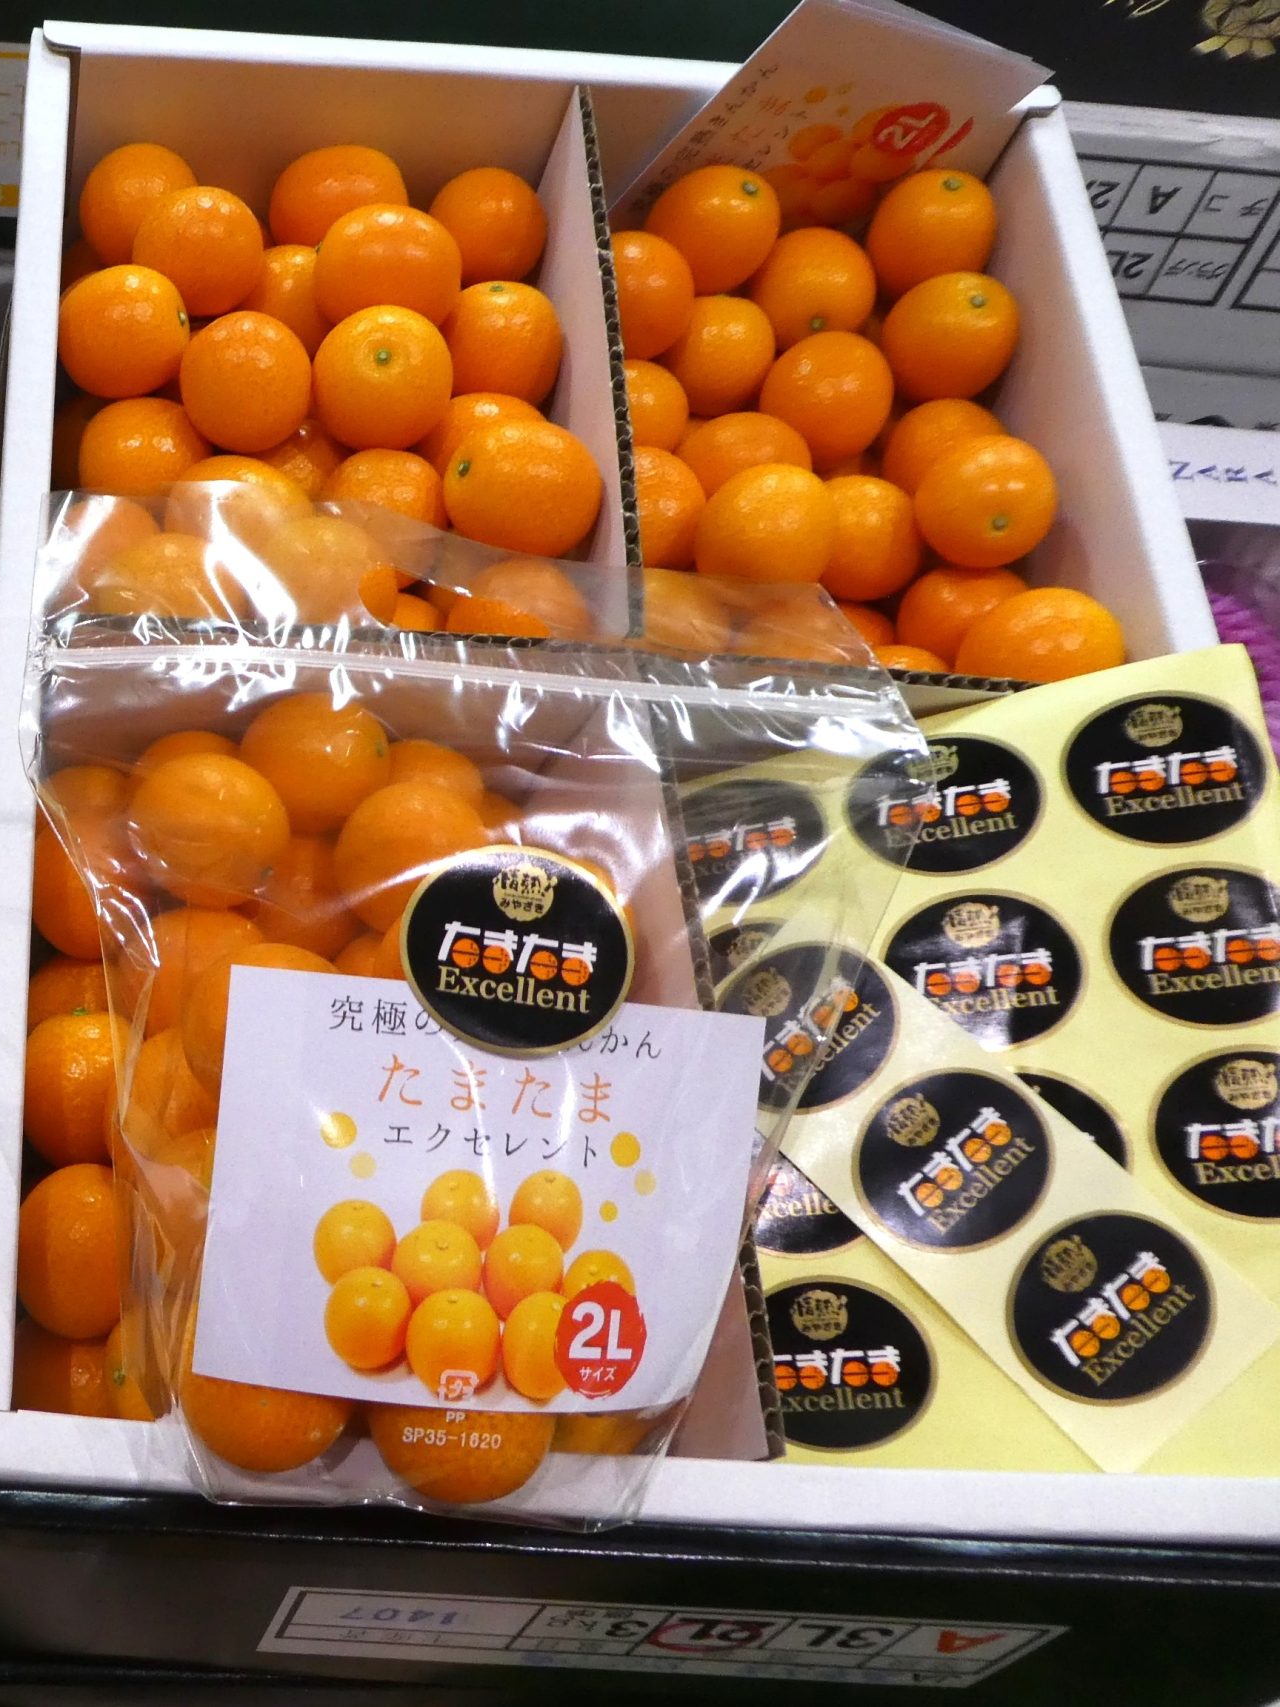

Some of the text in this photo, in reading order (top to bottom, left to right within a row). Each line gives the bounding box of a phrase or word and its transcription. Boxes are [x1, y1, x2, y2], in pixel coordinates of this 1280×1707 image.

[1148, 185, 1183, 215] A
[1096, 746, 1238, 795] たまたま
[1103, 781, 1245, 817] Excellent
[884, 812, 1018, 848] Excellent
[437, 920, 597, 988] たまたま
[913, 947, 1053, 996] たまたま
[435, 965, 591, 1014] Excellent
[1149, 964, 1280, 995] Excellen
[377, 1053, 614, 1125] たまたま
[384, 1121, 598, 1169] エクセレント
[898, 1106, 1013, 1218] たまたま
[926, 1135, 1037, 1234] Excellent
[568, 1301, 633, 1362] 2L
[1049, 1251, 1171, 1367] たまたま
[1082, 1284, 1196, 1386] Excellent
[578, 1364, 617, 1383] サイズ
[445, 1410, 467, 1424] PP
[780, 1387, 906, 1412] xcellent
[401, 1427, 503, 1451] SP35-1620
[798, 1624, 895, 1650] 3L
[937, 1629, 1009, 1655] A
